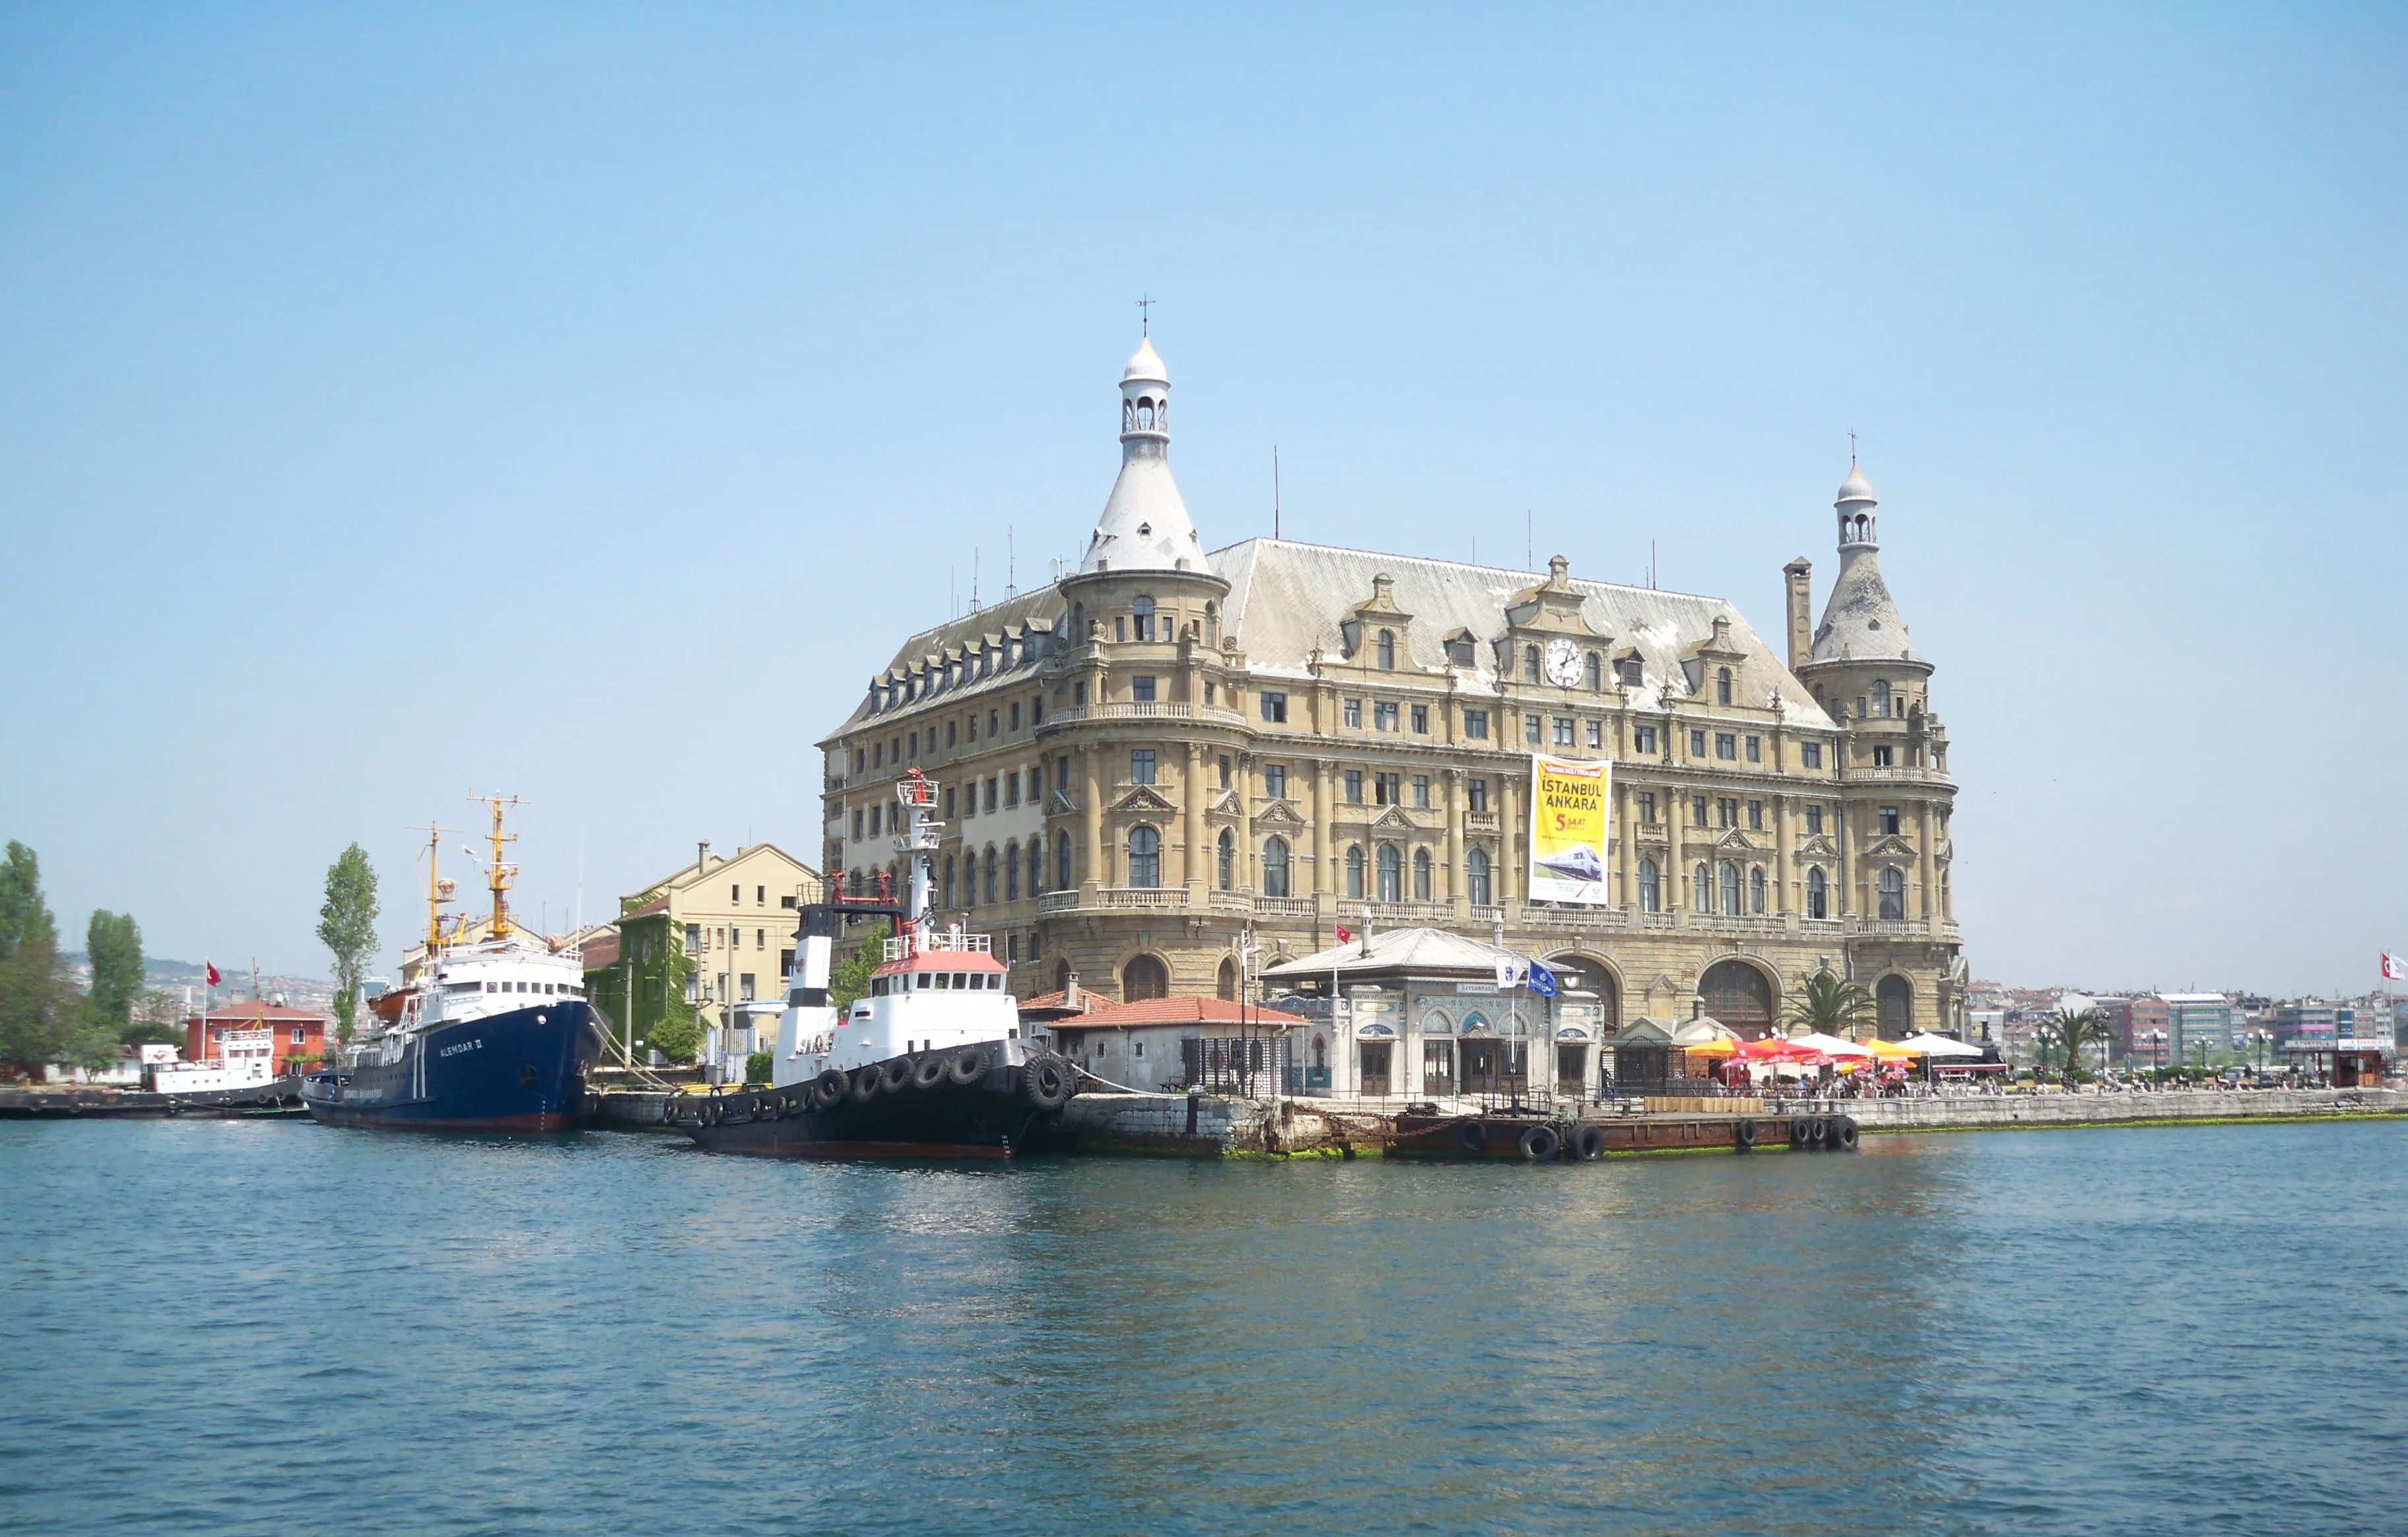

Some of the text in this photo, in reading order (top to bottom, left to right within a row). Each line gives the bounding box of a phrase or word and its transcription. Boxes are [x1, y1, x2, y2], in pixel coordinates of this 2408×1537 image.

[1542, 775, 1602, 797] İSTANBUL
[1546, 794, 1597, 811] ANKARA
[1555, 813, 1565, 831] 5
[440, 1042, 473, 1058] ALEMDAR
